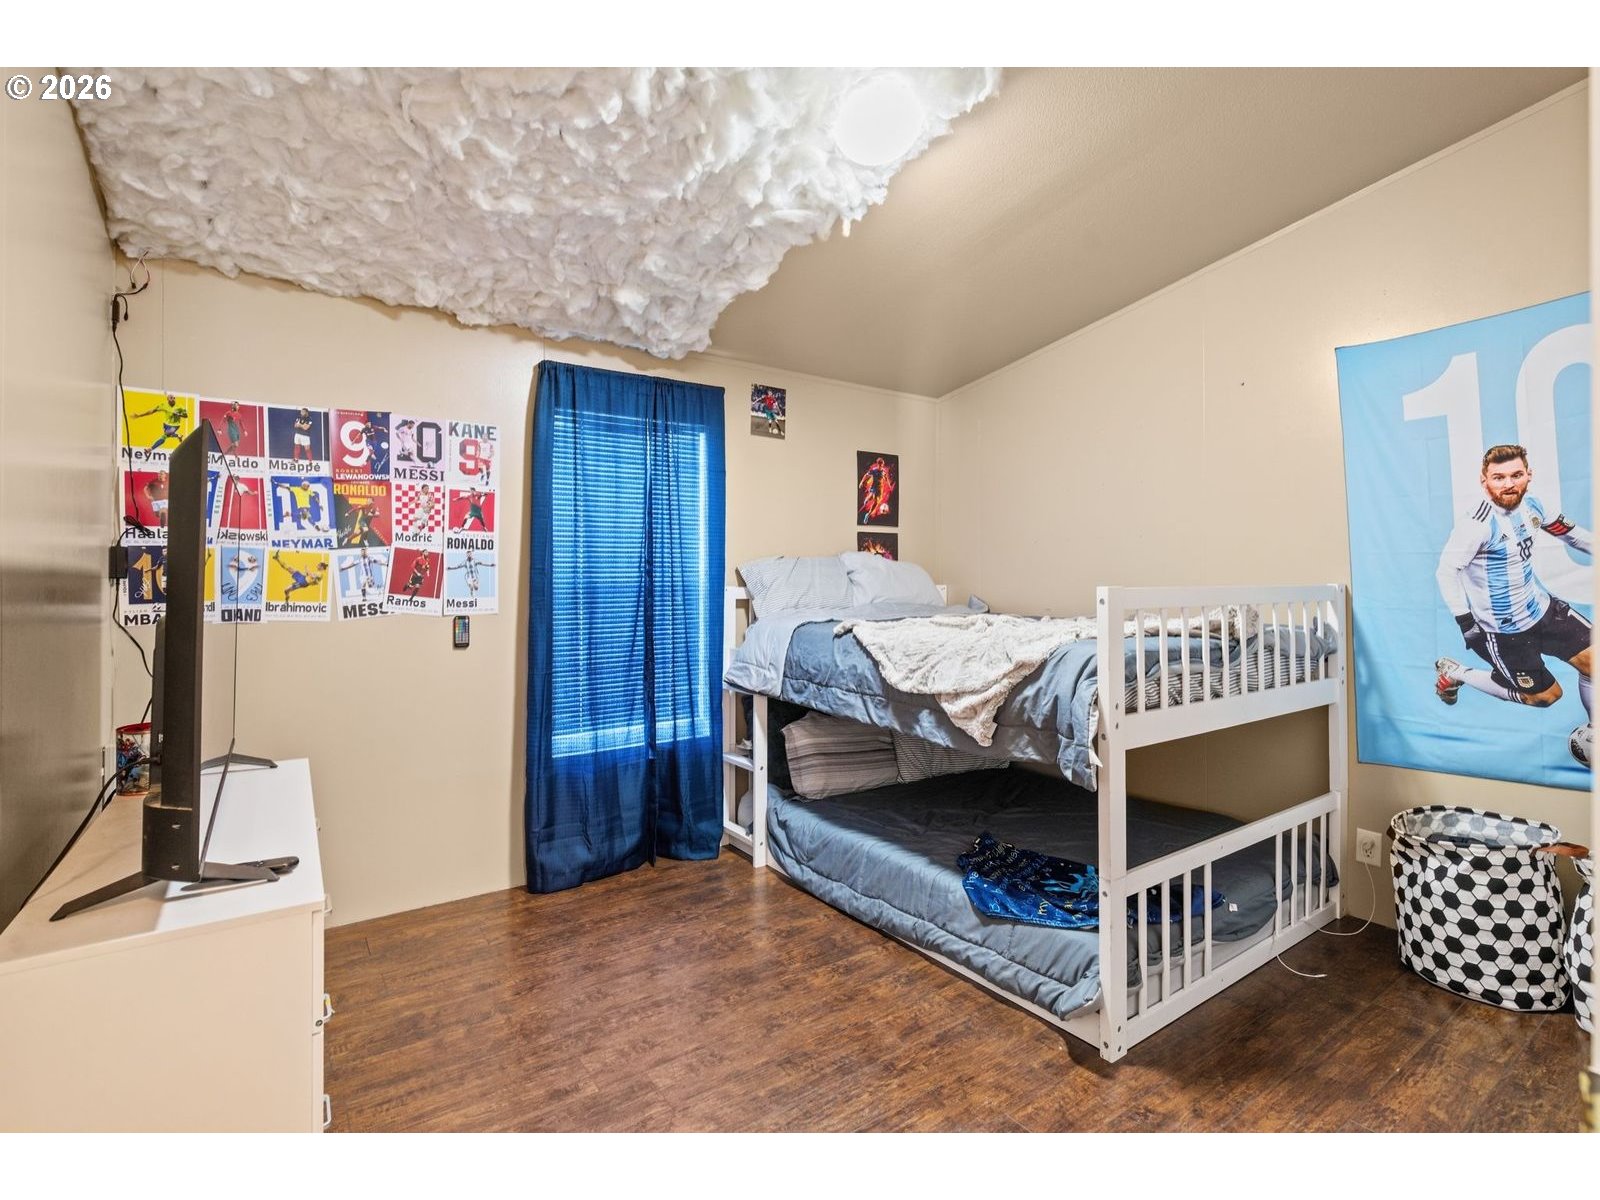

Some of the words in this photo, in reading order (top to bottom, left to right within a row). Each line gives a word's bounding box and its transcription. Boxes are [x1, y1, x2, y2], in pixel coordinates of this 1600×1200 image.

[449, 421, 497, 442] KANE
[340, 420, 370, 466] 9
[121, 447, 170, 462] Neym
[458, 438, 481, 476] 9
[269, 459, 320, 472] Mbappé
[394, 467, 445, 482] MESSI
[333, 483, 387, 497] RONALDO
[125, 528, 168, 539] Haala
[272, 538, 333, 549] NEYMAR
[446, 537, 495, 550] RONALDO
[1516, 536, 1534, 563] 10
[265, 602, 327, 613] Ibrahimovic
[386, 595, 427, 608] Ramos
[446, 598, 478, 609] Messi
[342, 602, 396, 619] MESS
[124, 613, 162, 626] MBA
